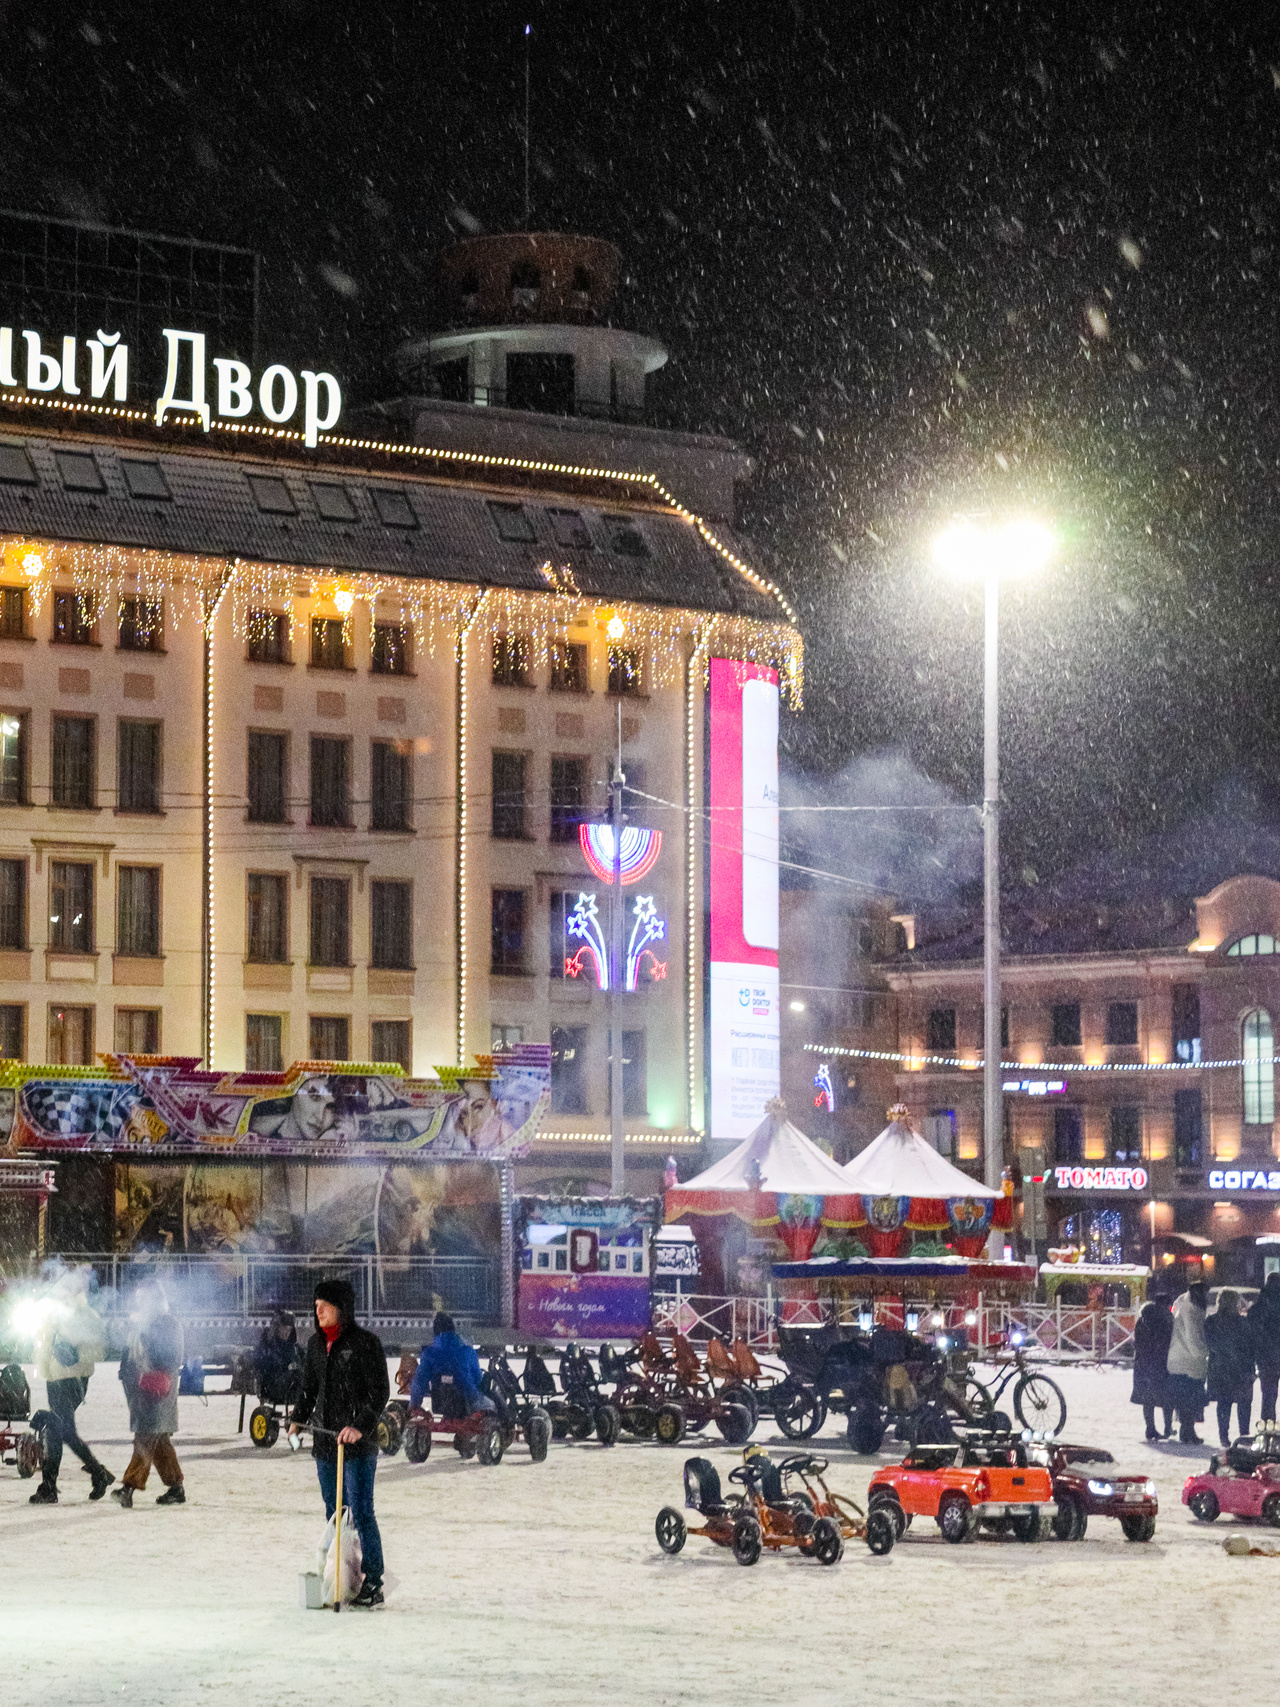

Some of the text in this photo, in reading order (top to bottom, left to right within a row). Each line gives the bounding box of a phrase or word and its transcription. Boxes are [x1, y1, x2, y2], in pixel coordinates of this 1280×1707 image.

[155, 328, 342, 448] Двор
[1054, 1167, 1148, 1191] TOMATO
[1209, 1170, 1280, 1190] СОГАЗ
[539, 1297, 574, 1312] Новым
[577, 1304, 606, 1319] годом
